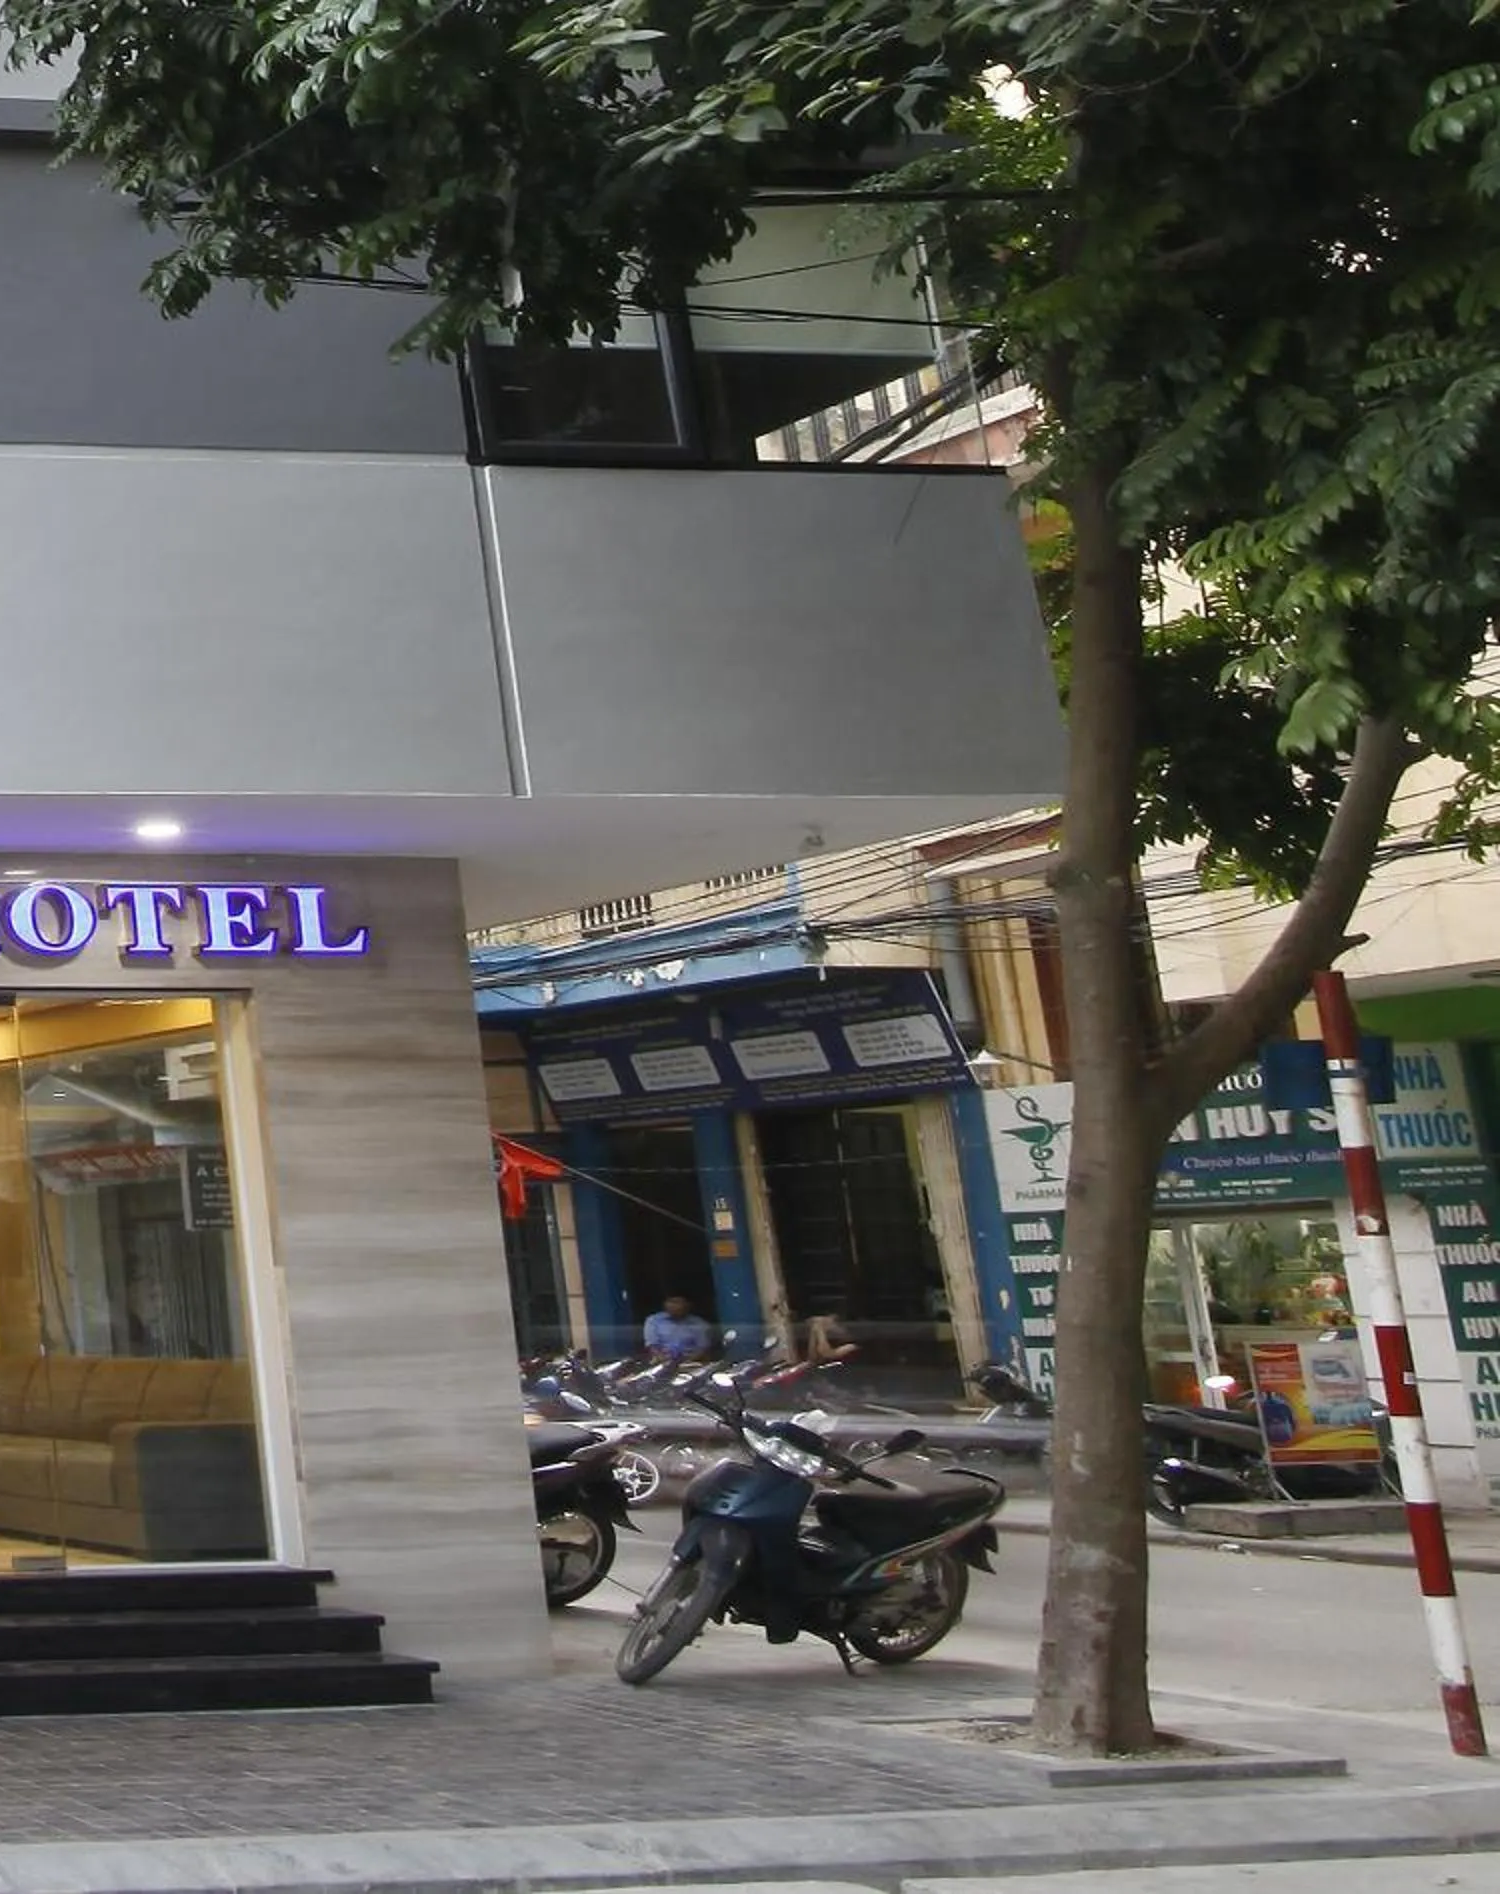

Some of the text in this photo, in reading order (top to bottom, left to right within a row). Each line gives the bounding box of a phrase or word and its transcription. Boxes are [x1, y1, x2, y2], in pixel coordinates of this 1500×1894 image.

[1393, 1048, 1446, 1091] NHÀ
[1378, 1100, 1474, 1149] THUỐC
[1014, 1187, 1065, 1200] PHARMA
[1436, 1200, 1488, 1228] NHÀ
[1462, 1280, 1498, 1304] AN
